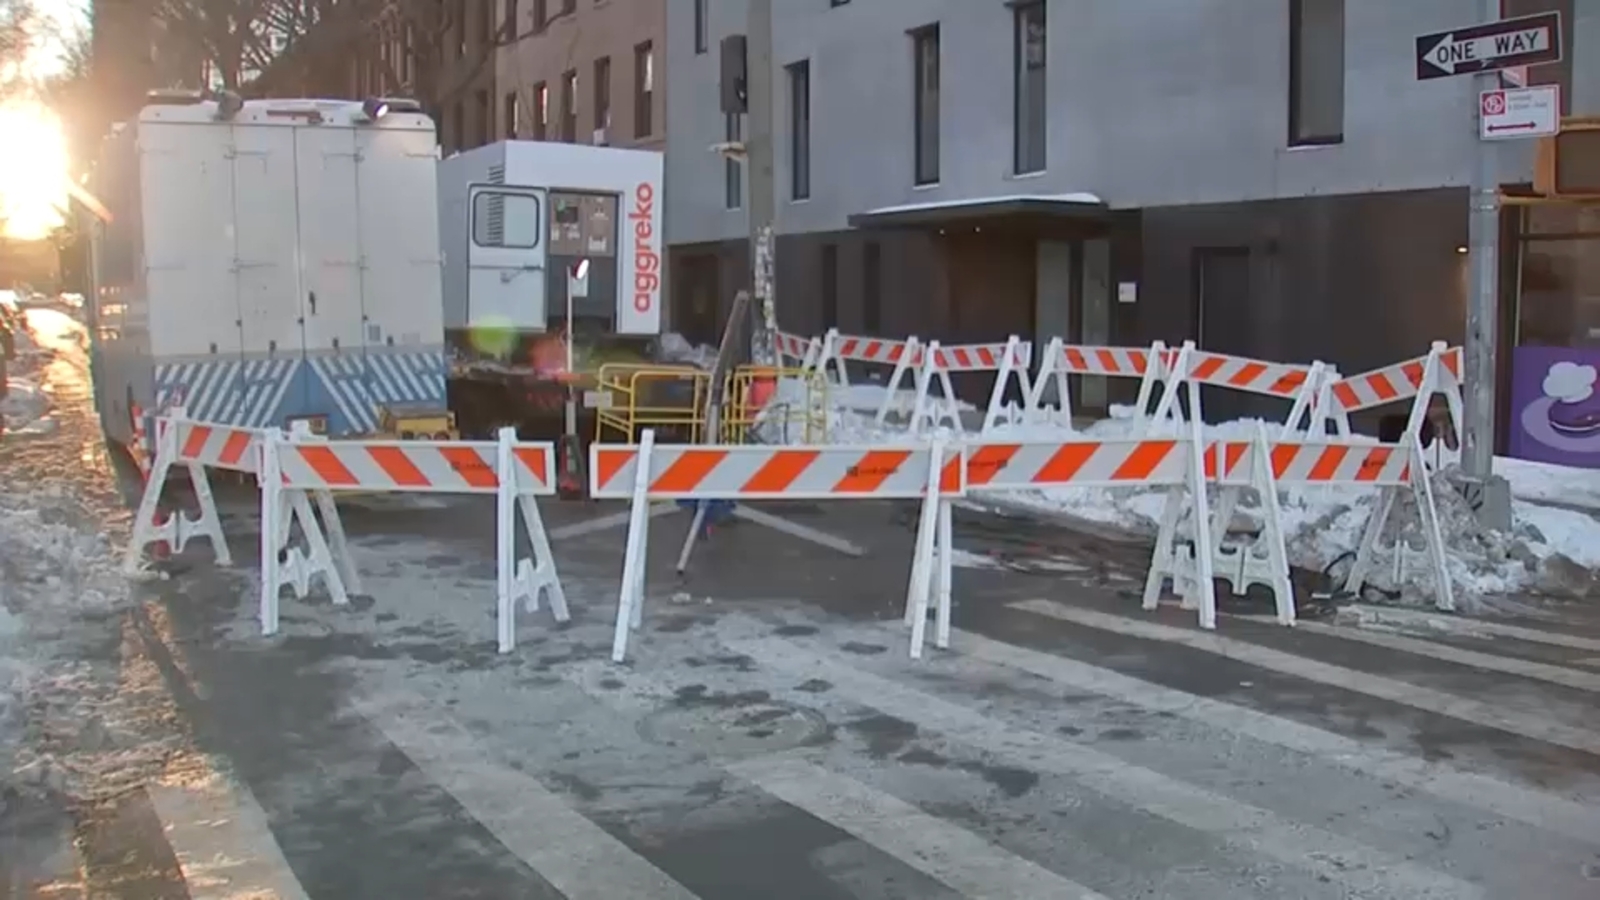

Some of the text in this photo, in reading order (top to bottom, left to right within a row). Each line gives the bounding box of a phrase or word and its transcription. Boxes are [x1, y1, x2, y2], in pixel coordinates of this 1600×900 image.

[1436, 31, 1538, 64] ONE WAY
[628, 182, 659, 313] aggreko
